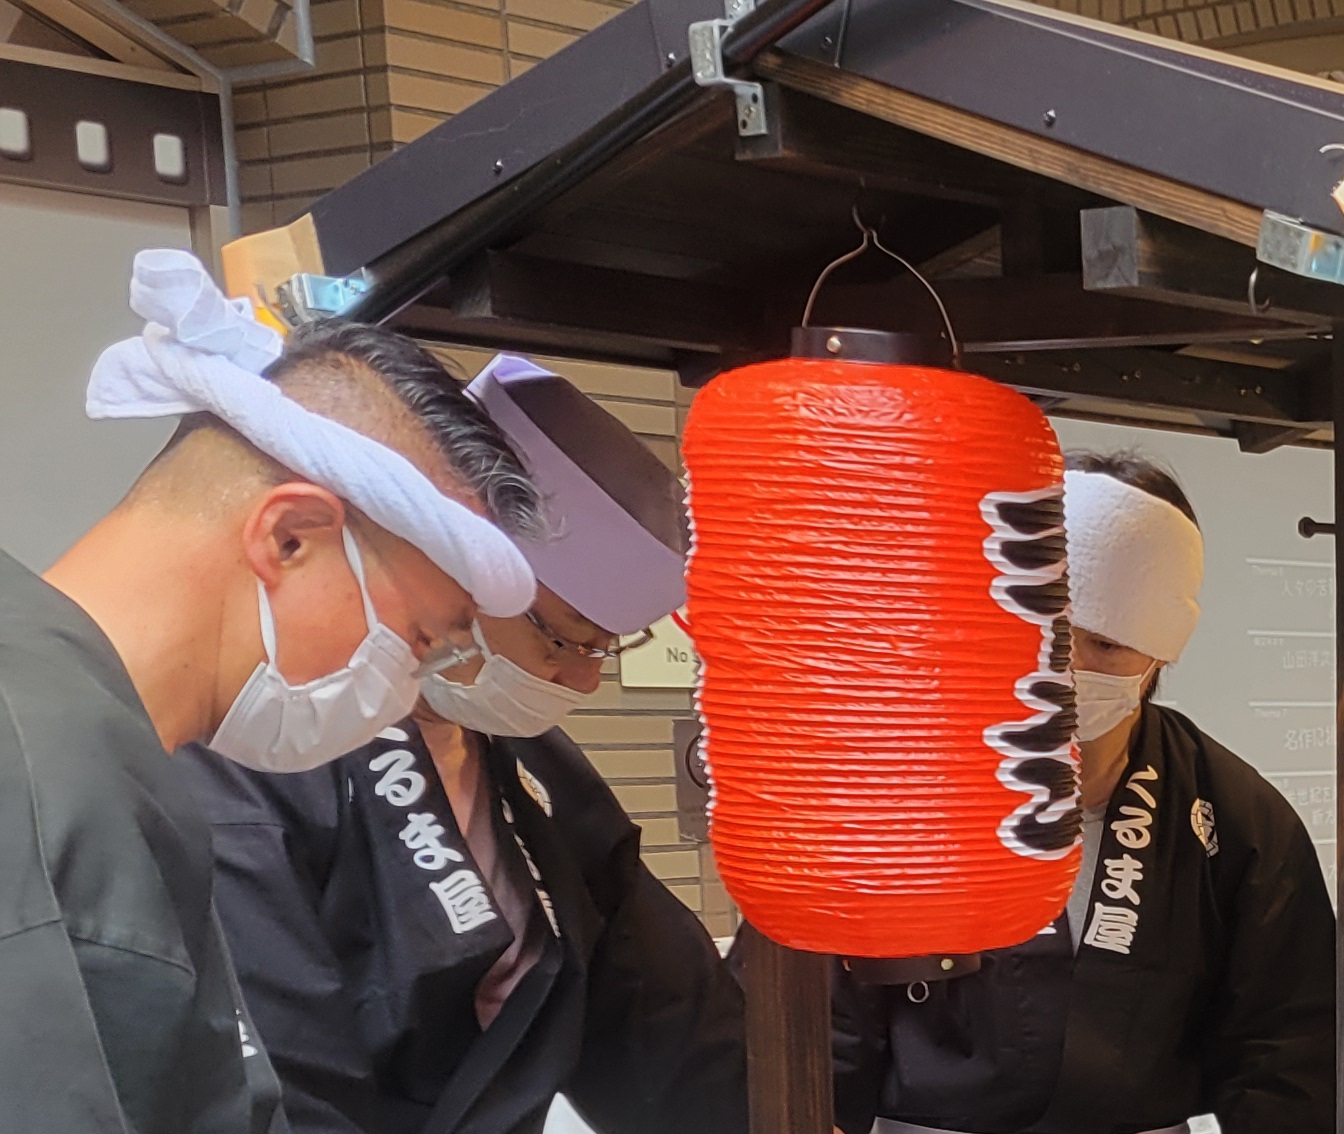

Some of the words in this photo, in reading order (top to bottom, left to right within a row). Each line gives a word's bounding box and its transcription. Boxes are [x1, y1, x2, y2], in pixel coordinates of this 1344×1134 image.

[666, 647, 689, 663] No
[1083, 763, 1159, 955] くるま屋
